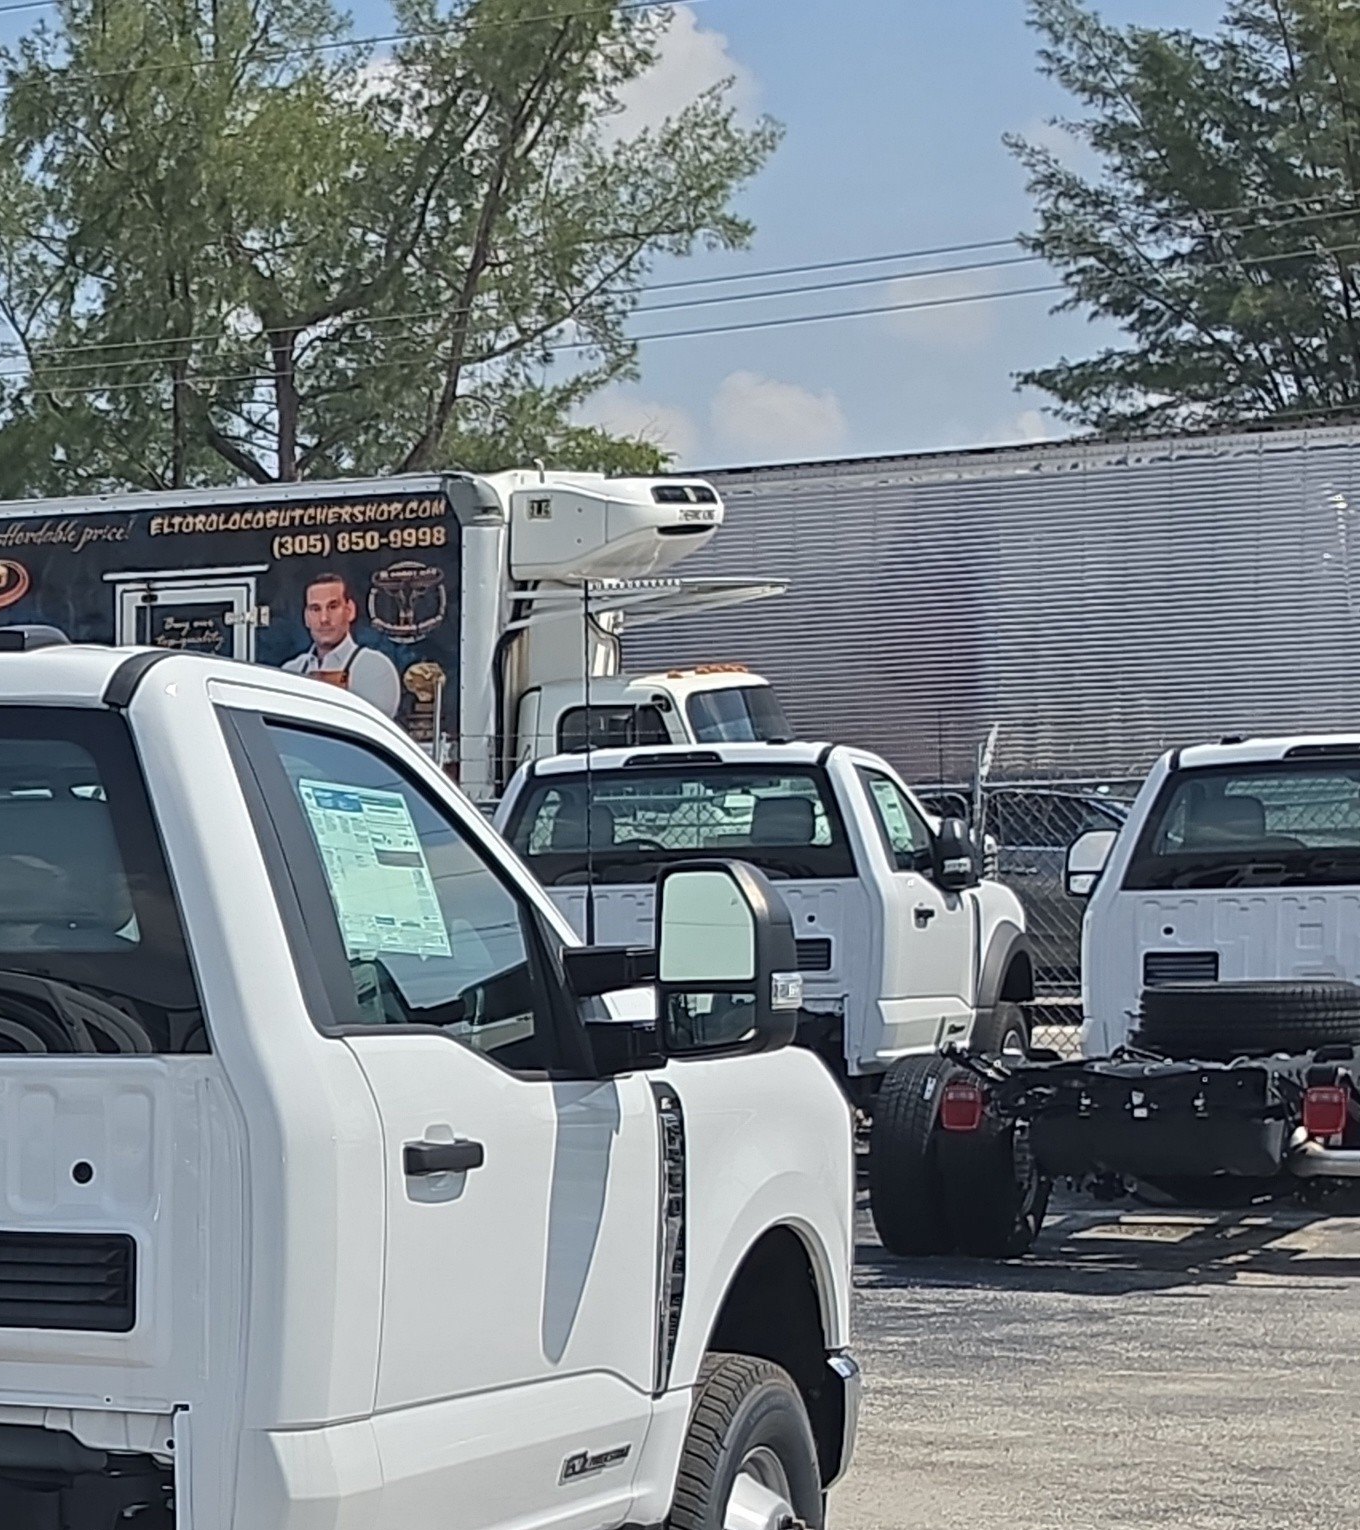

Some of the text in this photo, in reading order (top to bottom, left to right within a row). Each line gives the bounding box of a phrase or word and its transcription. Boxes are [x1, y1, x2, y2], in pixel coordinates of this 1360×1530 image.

[72, 515, 138, 553] price!
[149, 498, 446, 536] ELTOROLOCOBUTCHERSHOP.COM
[273, 526, 446, 559] (305) 850-9998
